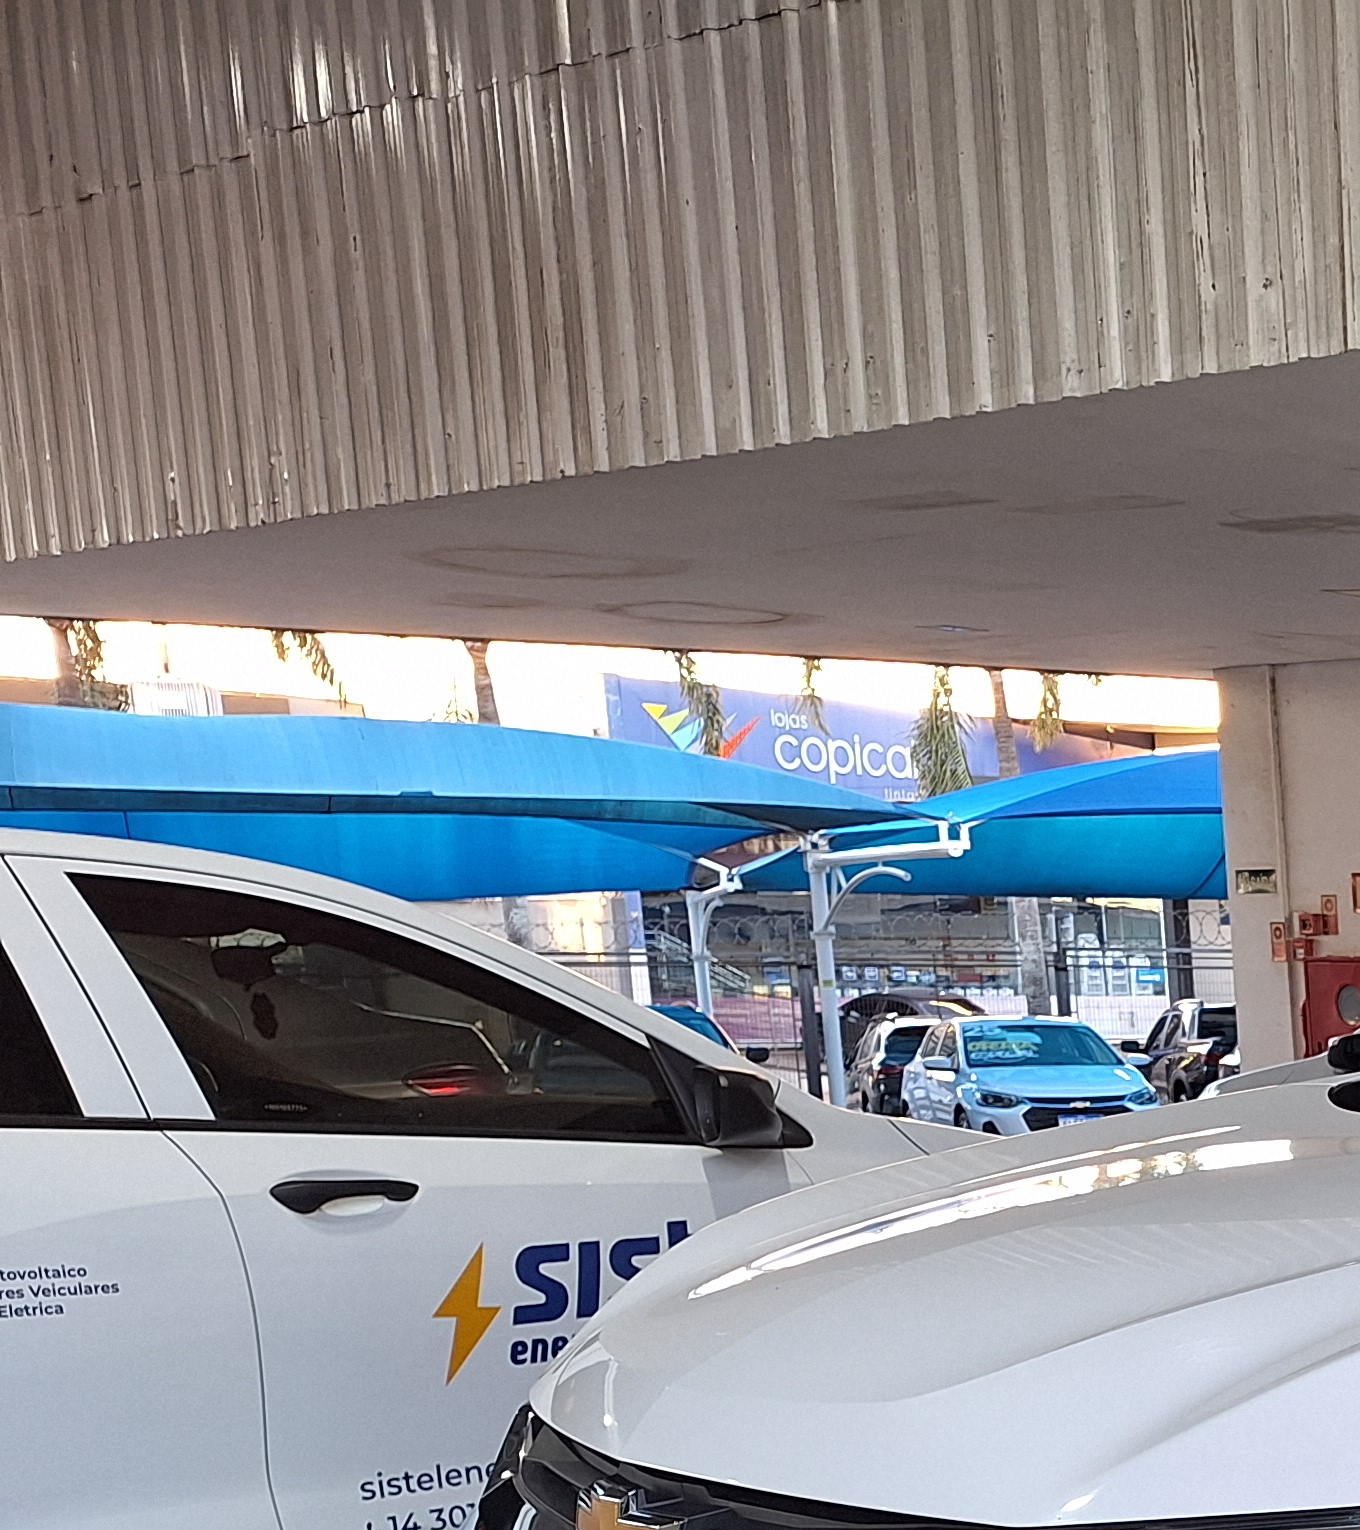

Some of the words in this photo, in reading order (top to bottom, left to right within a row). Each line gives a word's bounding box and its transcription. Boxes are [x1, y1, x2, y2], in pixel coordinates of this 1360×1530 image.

[770, 708, 808, 730] lojas
[28, 1282, 120, 1298] Veiculares
[0, 1301, 65, 1319] Eletrica
